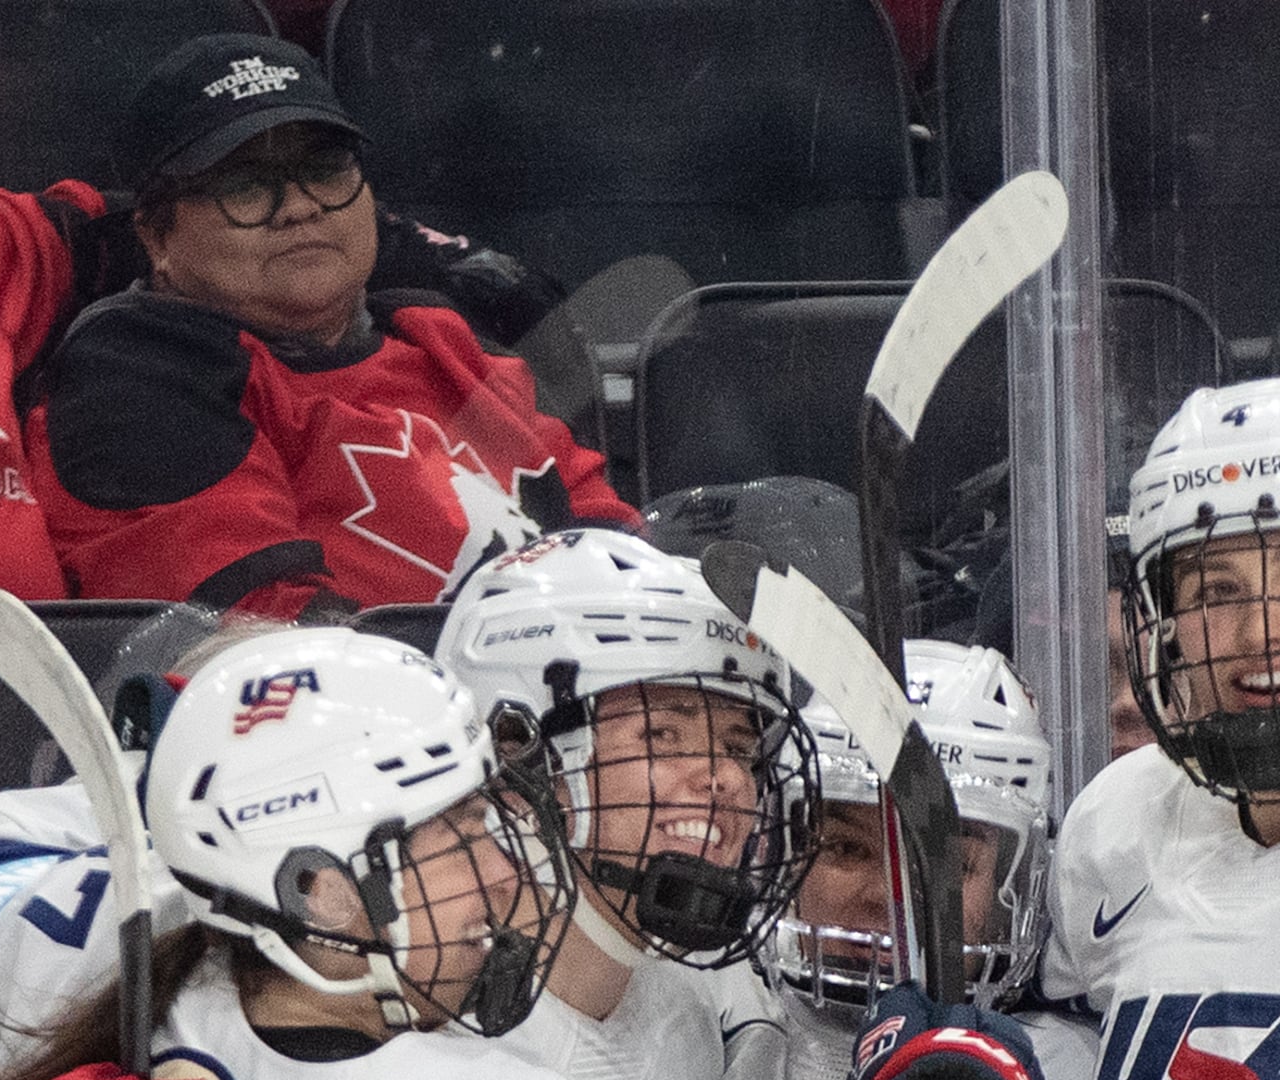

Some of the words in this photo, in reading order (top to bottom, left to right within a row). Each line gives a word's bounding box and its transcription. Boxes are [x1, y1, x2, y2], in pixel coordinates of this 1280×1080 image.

[203, 66, 300, 97] WORKING
[231, 79, 287, 100] LATE
[1221, 404, 1251, 427] 4
[233, 668, 320, 735] USA
[237, 788, 319, 822] CCM
[18, 852, 112, 950] 7
